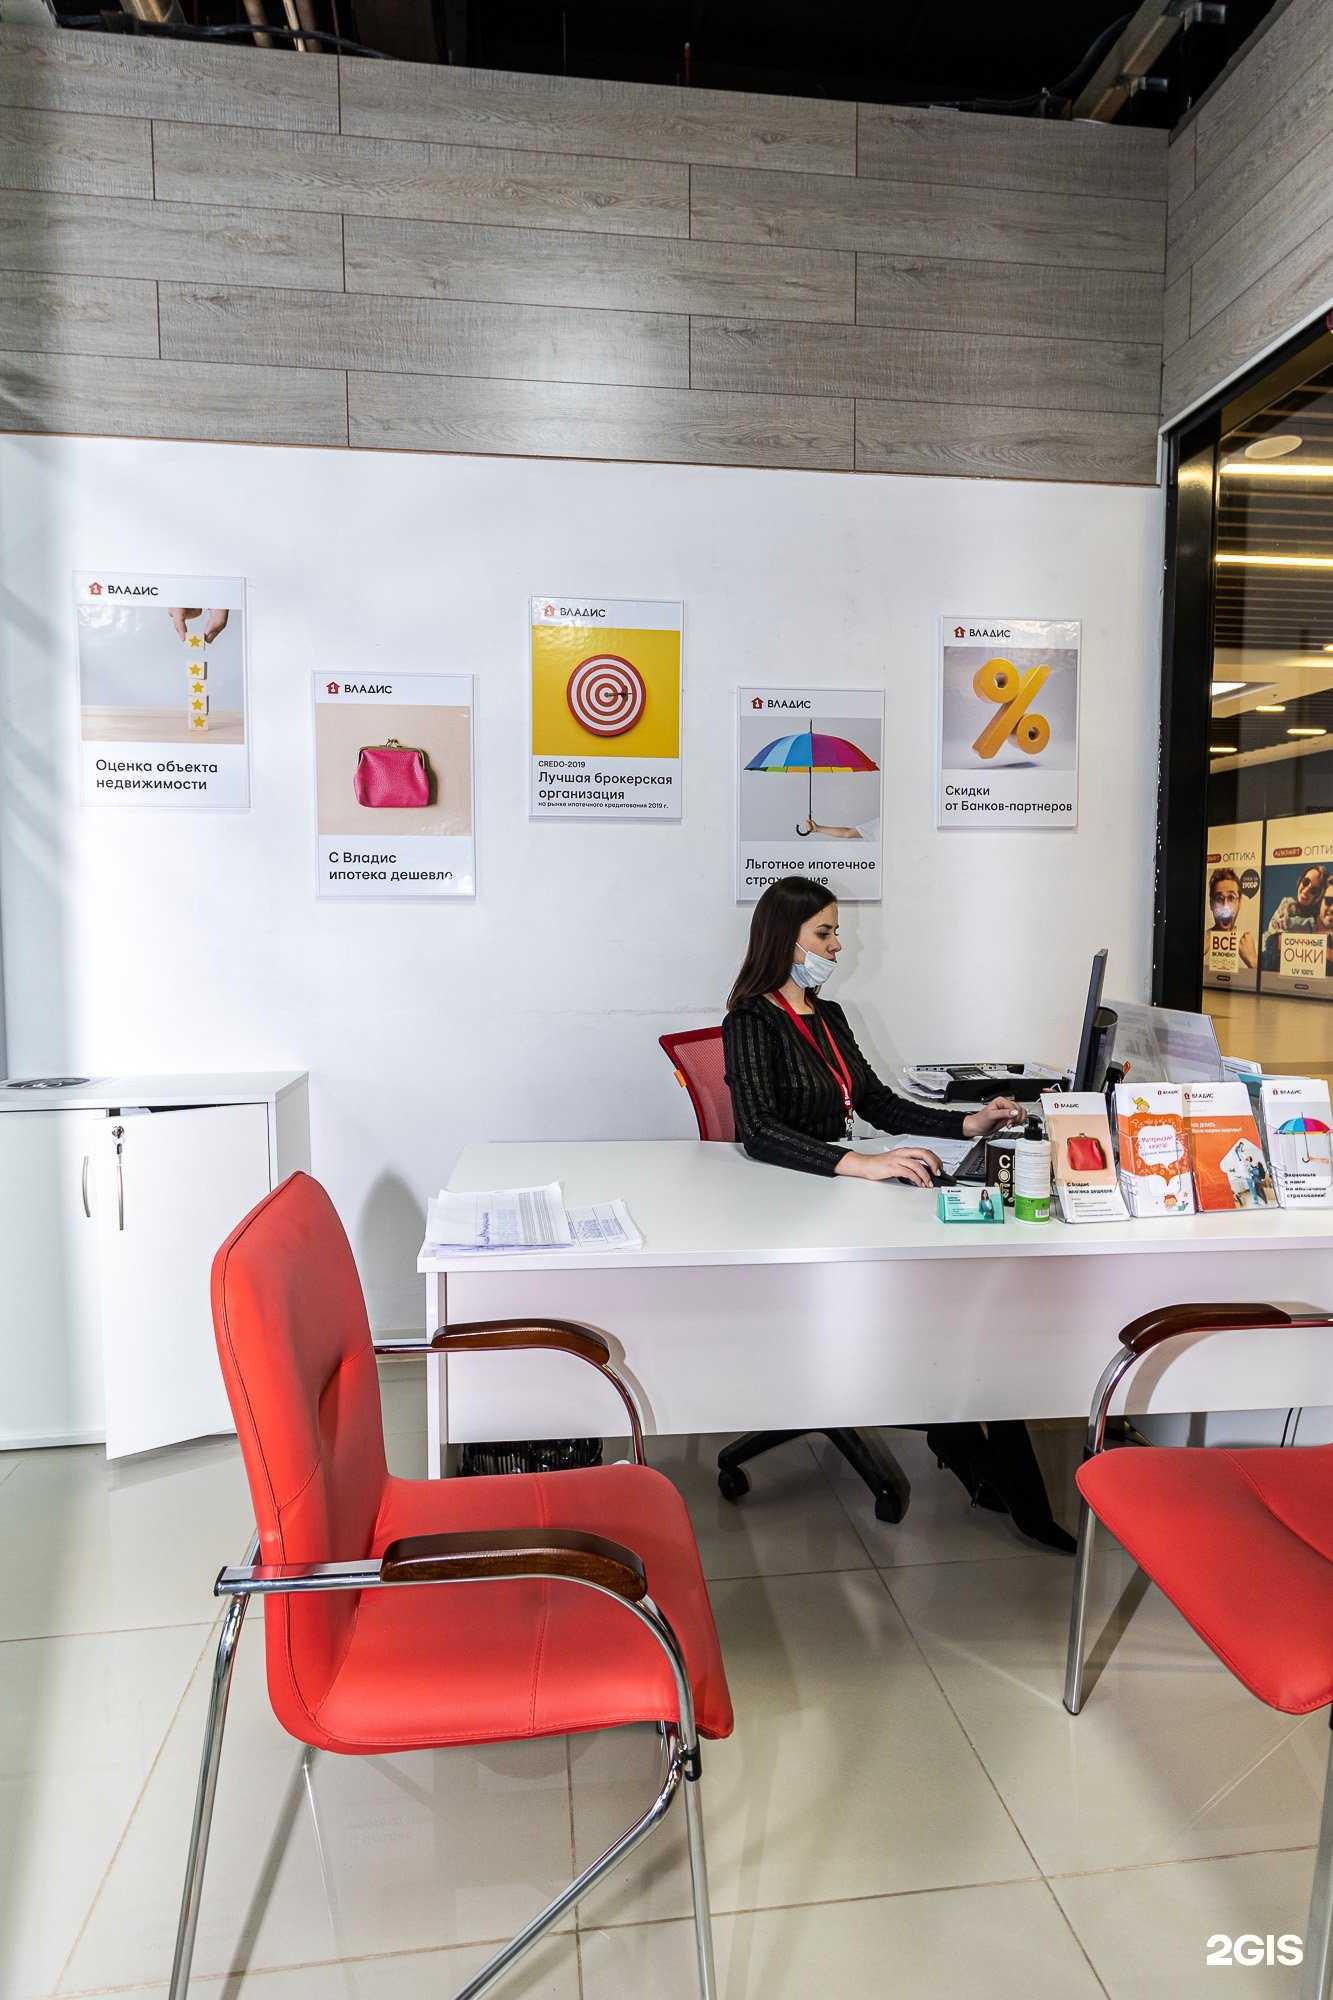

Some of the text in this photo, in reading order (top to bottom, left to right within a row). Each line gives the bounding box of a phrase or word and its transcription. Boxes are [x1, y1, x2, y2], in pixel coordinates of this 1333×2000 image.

[108, 584, 158, 596] ВЛАДИС
[560, 607, 606, 618] ВЛАДИС
[970, 628, 1011, 638] ВЛАДИС
[344, 684, 392, 694] ВЛАДИС
[767, 699, 812, 709] ВЛАДИС
[96, 759, 218, 773] Оценка объекта
[538, 760, 586, 768] CREDO-2019
[96, 778, 208, 790] недвижимости
[538, 772, 673, 786] Лучшая брокерская
[538, 789, 625, 800] организация
[945, 785, 990, 797] Скидки
[945, 800, 1072, 813] от Банков-партнеров
[328, 852, 397, 864] С Владис
[745, 858, 876, 870] Льготное ипотечное
[329, 870, 387, 880] ипотека
[1212, 932, 1237, 952] ВСЁ
[1284, 948, 1324, 964] ОЧКИ
